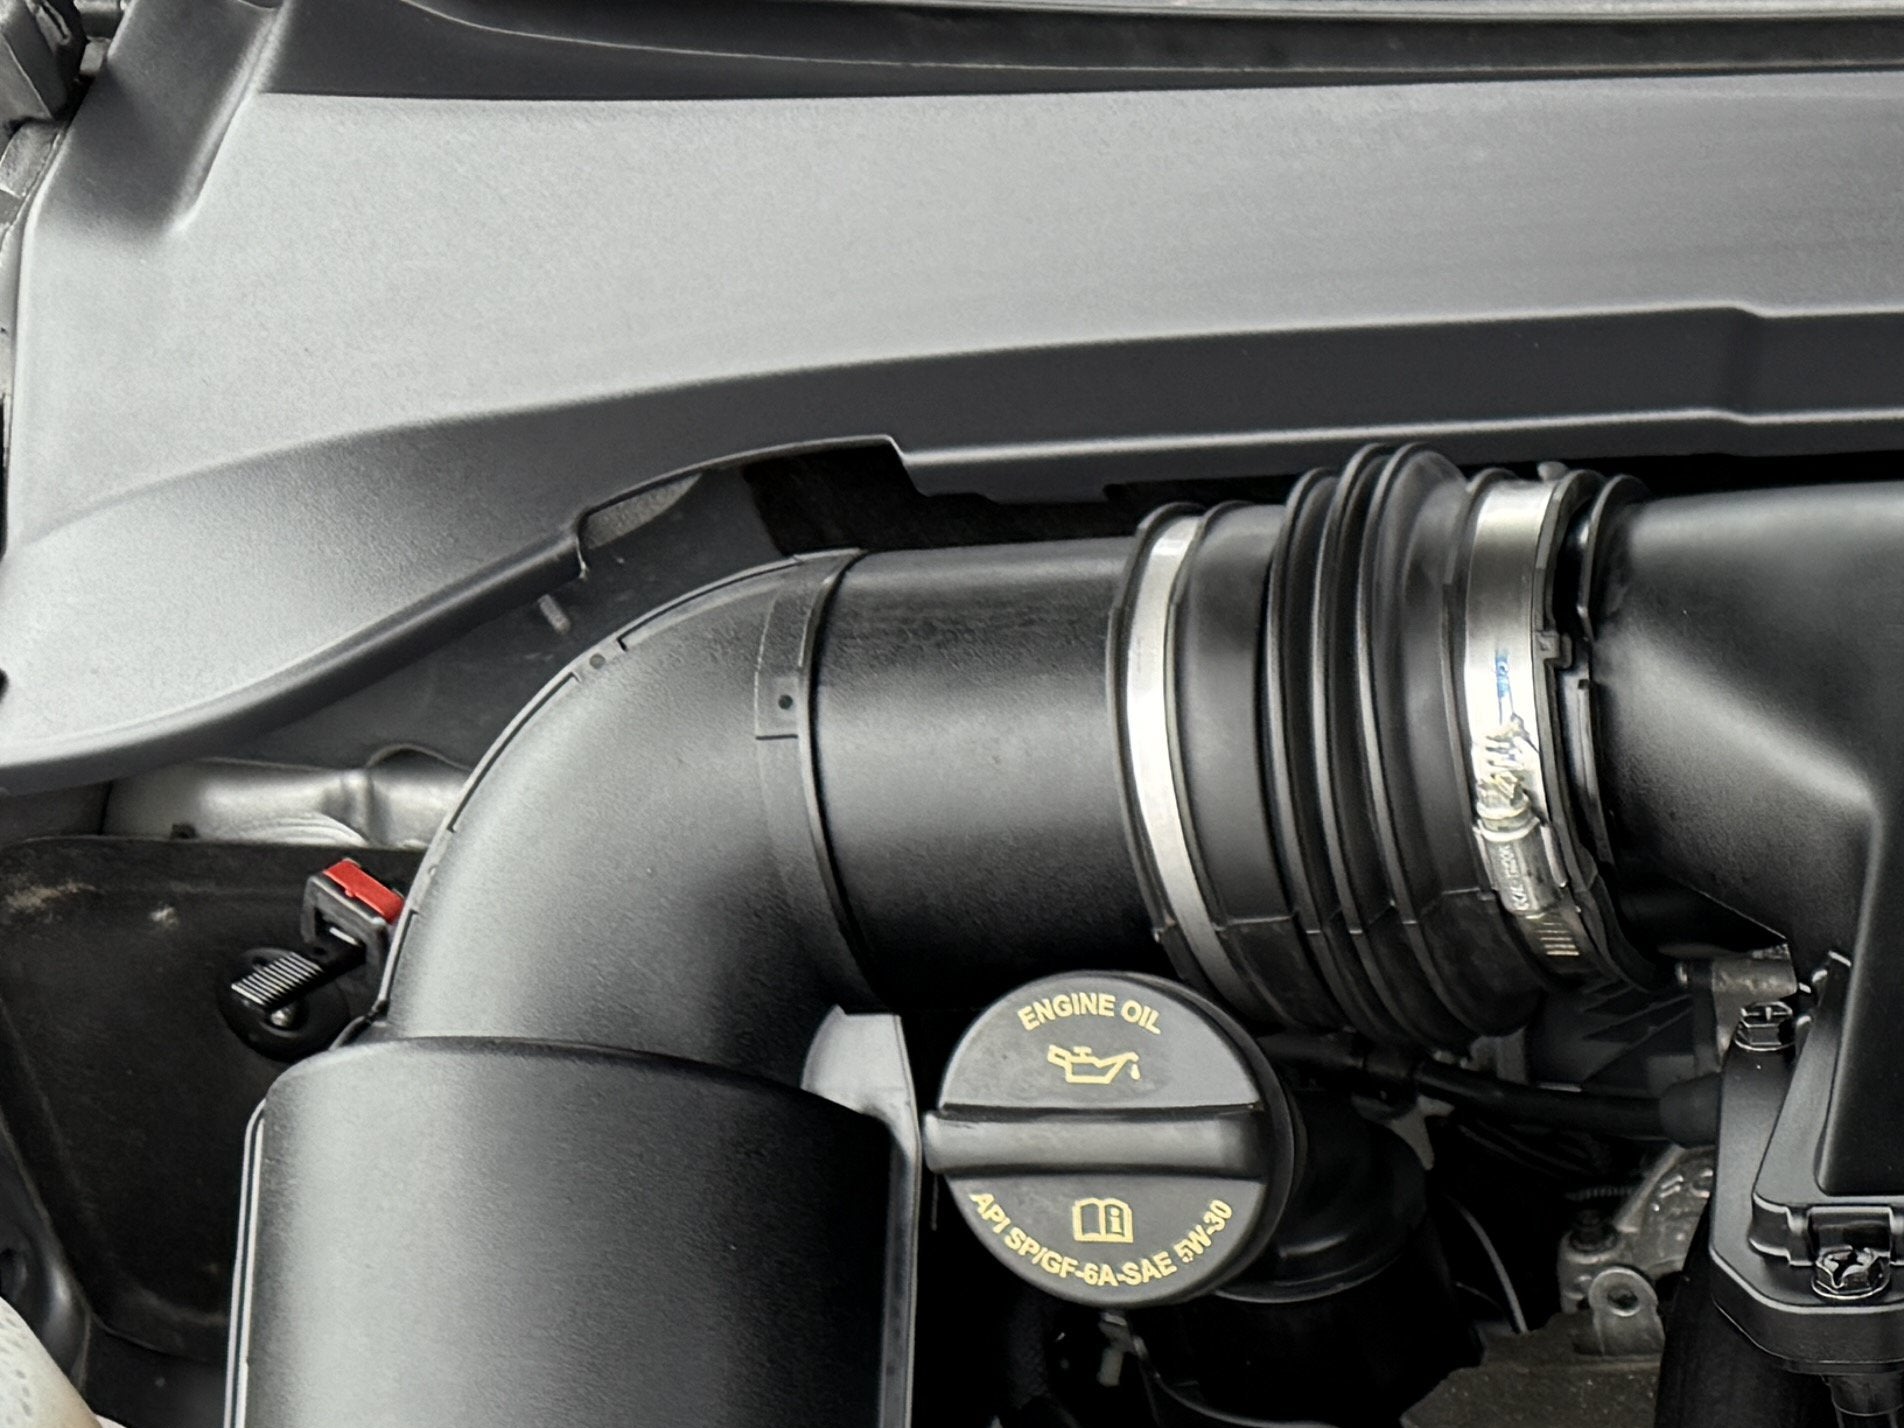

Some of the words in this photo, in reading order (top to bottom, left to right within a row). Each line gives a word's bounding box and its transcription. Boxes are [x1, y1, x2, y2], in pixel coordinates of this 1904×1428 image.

[1017, 992, 1116, 1031] ENGINE
[1121, 1000, 1161, 1035] OIL
[969, 1192, 1011, 1234] API
[1173, 1199, 1233, 1263] 5W-30
